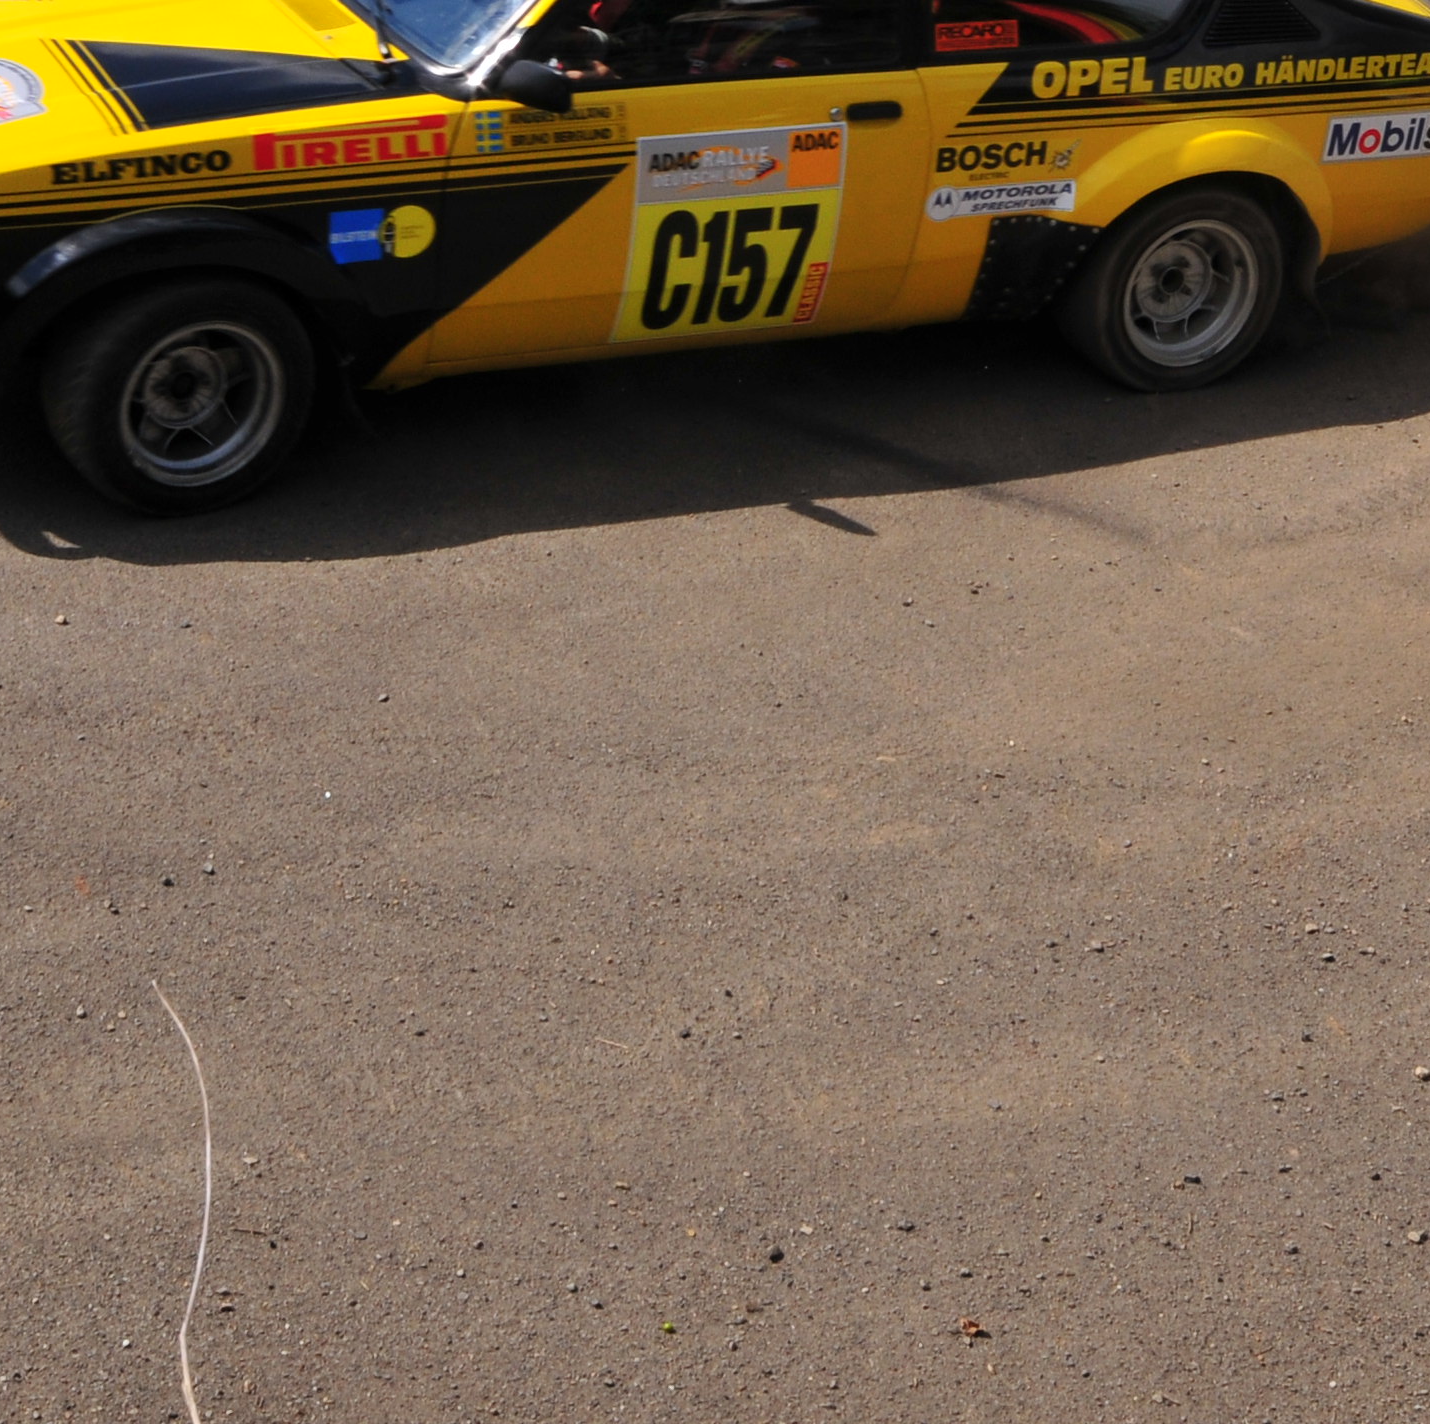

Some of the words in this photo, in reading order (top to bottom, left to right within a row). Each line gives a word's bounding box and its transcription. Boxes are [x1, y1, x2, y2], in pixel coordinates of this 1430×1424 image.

[938, 23, 1003, 41] RECARO
[1031, 56, 1154, 99] OPEL
[1164, 63, 1243, 92] EURO
[253, 114, 447, 170] PIRELLI
[791, 131, 839, 152] ADAC
[52, 150, 231, 185] ELFINCO
[649, 151, 699, 173] ADAC
[700, 145, 770, 168] RALLYE
[936, 141, 1047, 173] BOSCH
[962, 183, 1072, 202] MOTOROLA
[972, 197, 1058, 212] SPRECHFUNK
[641, 204, 819, 330] C157
